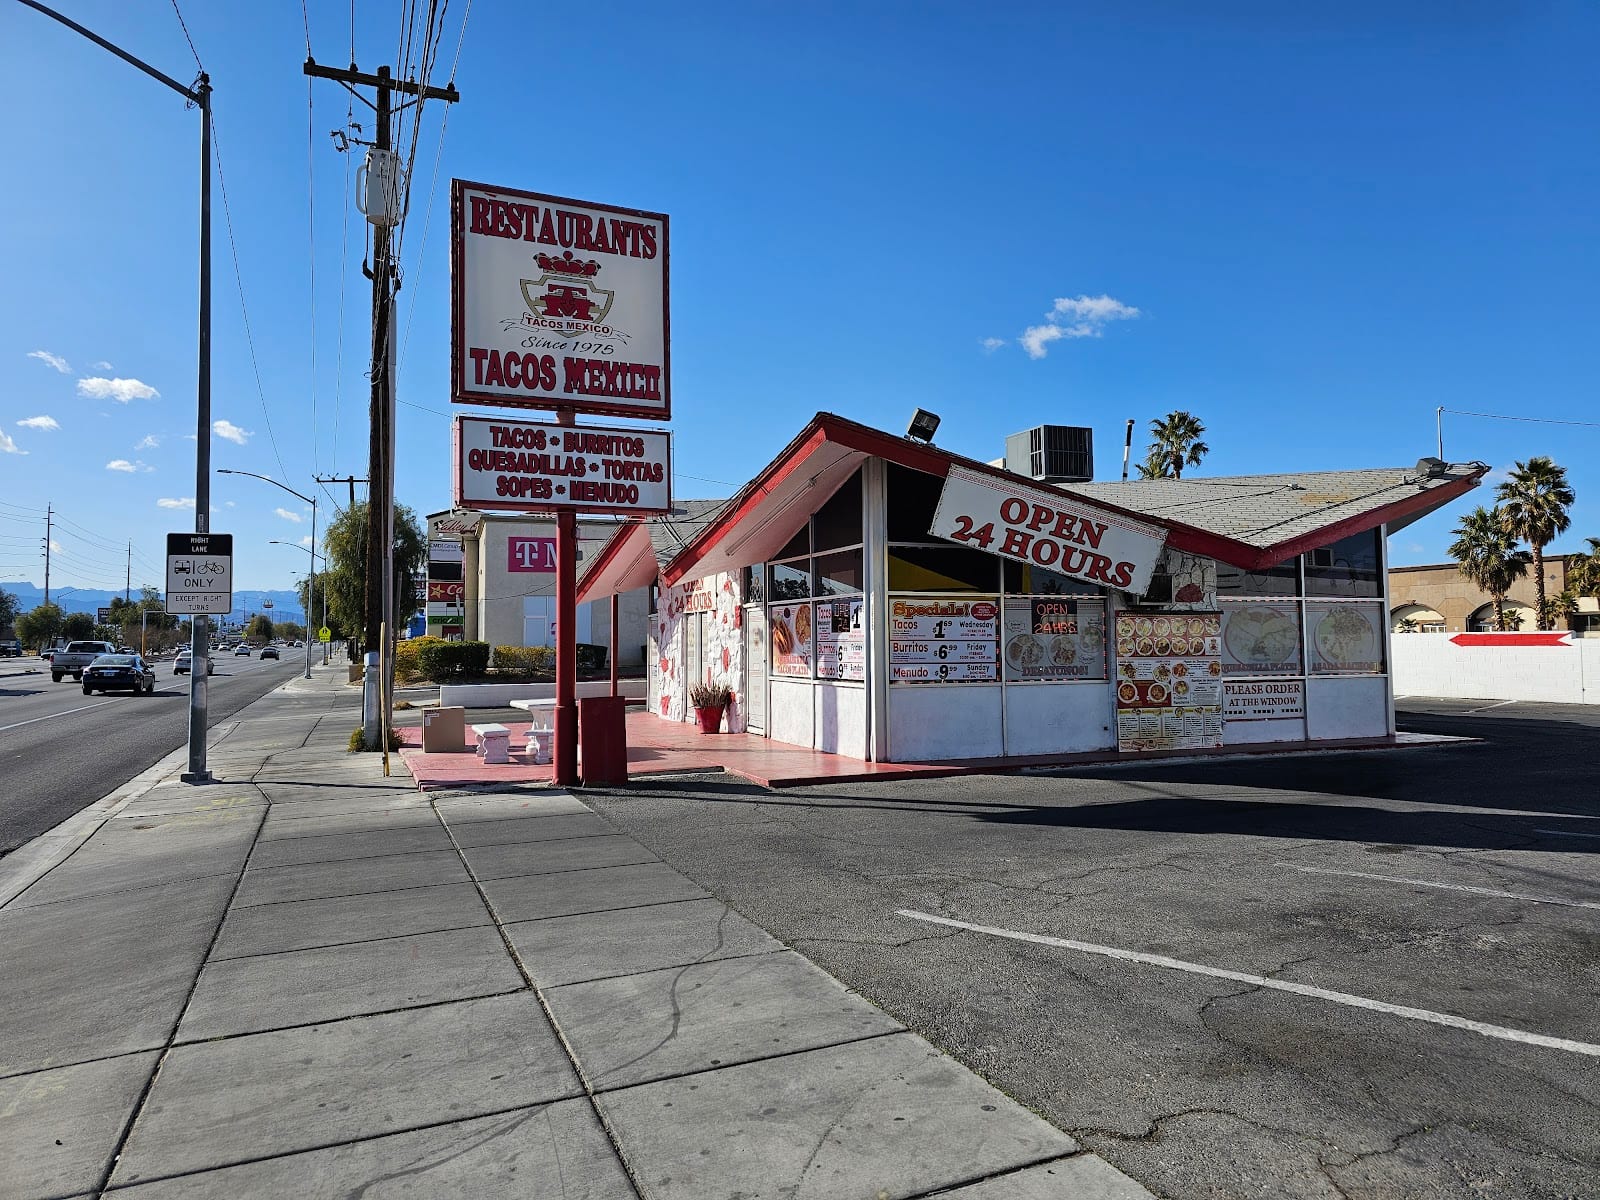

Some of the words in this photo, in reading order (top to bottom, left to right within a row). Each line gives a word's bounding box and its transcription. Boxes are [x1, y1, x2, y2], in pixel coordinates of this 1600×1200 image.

[470, 196, 657, 260] RESTAURANTS
[525, 316, 564, 330] TACOS
[566, 321, 610, 335] MEXICO
[521, 335, 568, 350] Since
[573, 341, 615, 355] 1975
[469, 347, 557, 392] TACOS
[563, 356, 662, 401] MEXICO
[490, 426, 547, 451] TACOS
[563, 432, 645, 458] BURRITOS
[468, 449, 587, 477] QUESADILLAS
[602, 459, 664, 483] TORTAS
[496, 476, 553, 500] SOPES
[569, 480, 640, 505] MENUDO
[1000, 497, 1109, 549] OPEN
[190, 536, 209, 544] RIGHT
[191, 545, 208, 553] LANE
[950, 515, 996, 549] 24
[999, 527, 1136, 588] HOURS
[184, 578, 214, 588] ONLY
[685, 591, 712, 612] HOURS
[892, 601, 971, 619] Specials!
[1036, 603, 1068, 615] OPEN
[893, 619, 918, 630] Tacos
[960, 620, 994, 629] Wednesday
[893, 641, 929, 653] Burritos
[966, 643, 987, 652] Friday
[893, 667, 929, 678] Menudo
[966, 664, 990, 672] Sunday
[1225, 684, 1263, 695] PLEASE
[1265, 683, 1301, 694] ORDER
[1229, 698, 1241, 707] AT
[1241, 698, 1259, 707] THE
[1261, 697, 1298, 706] WINDOW
